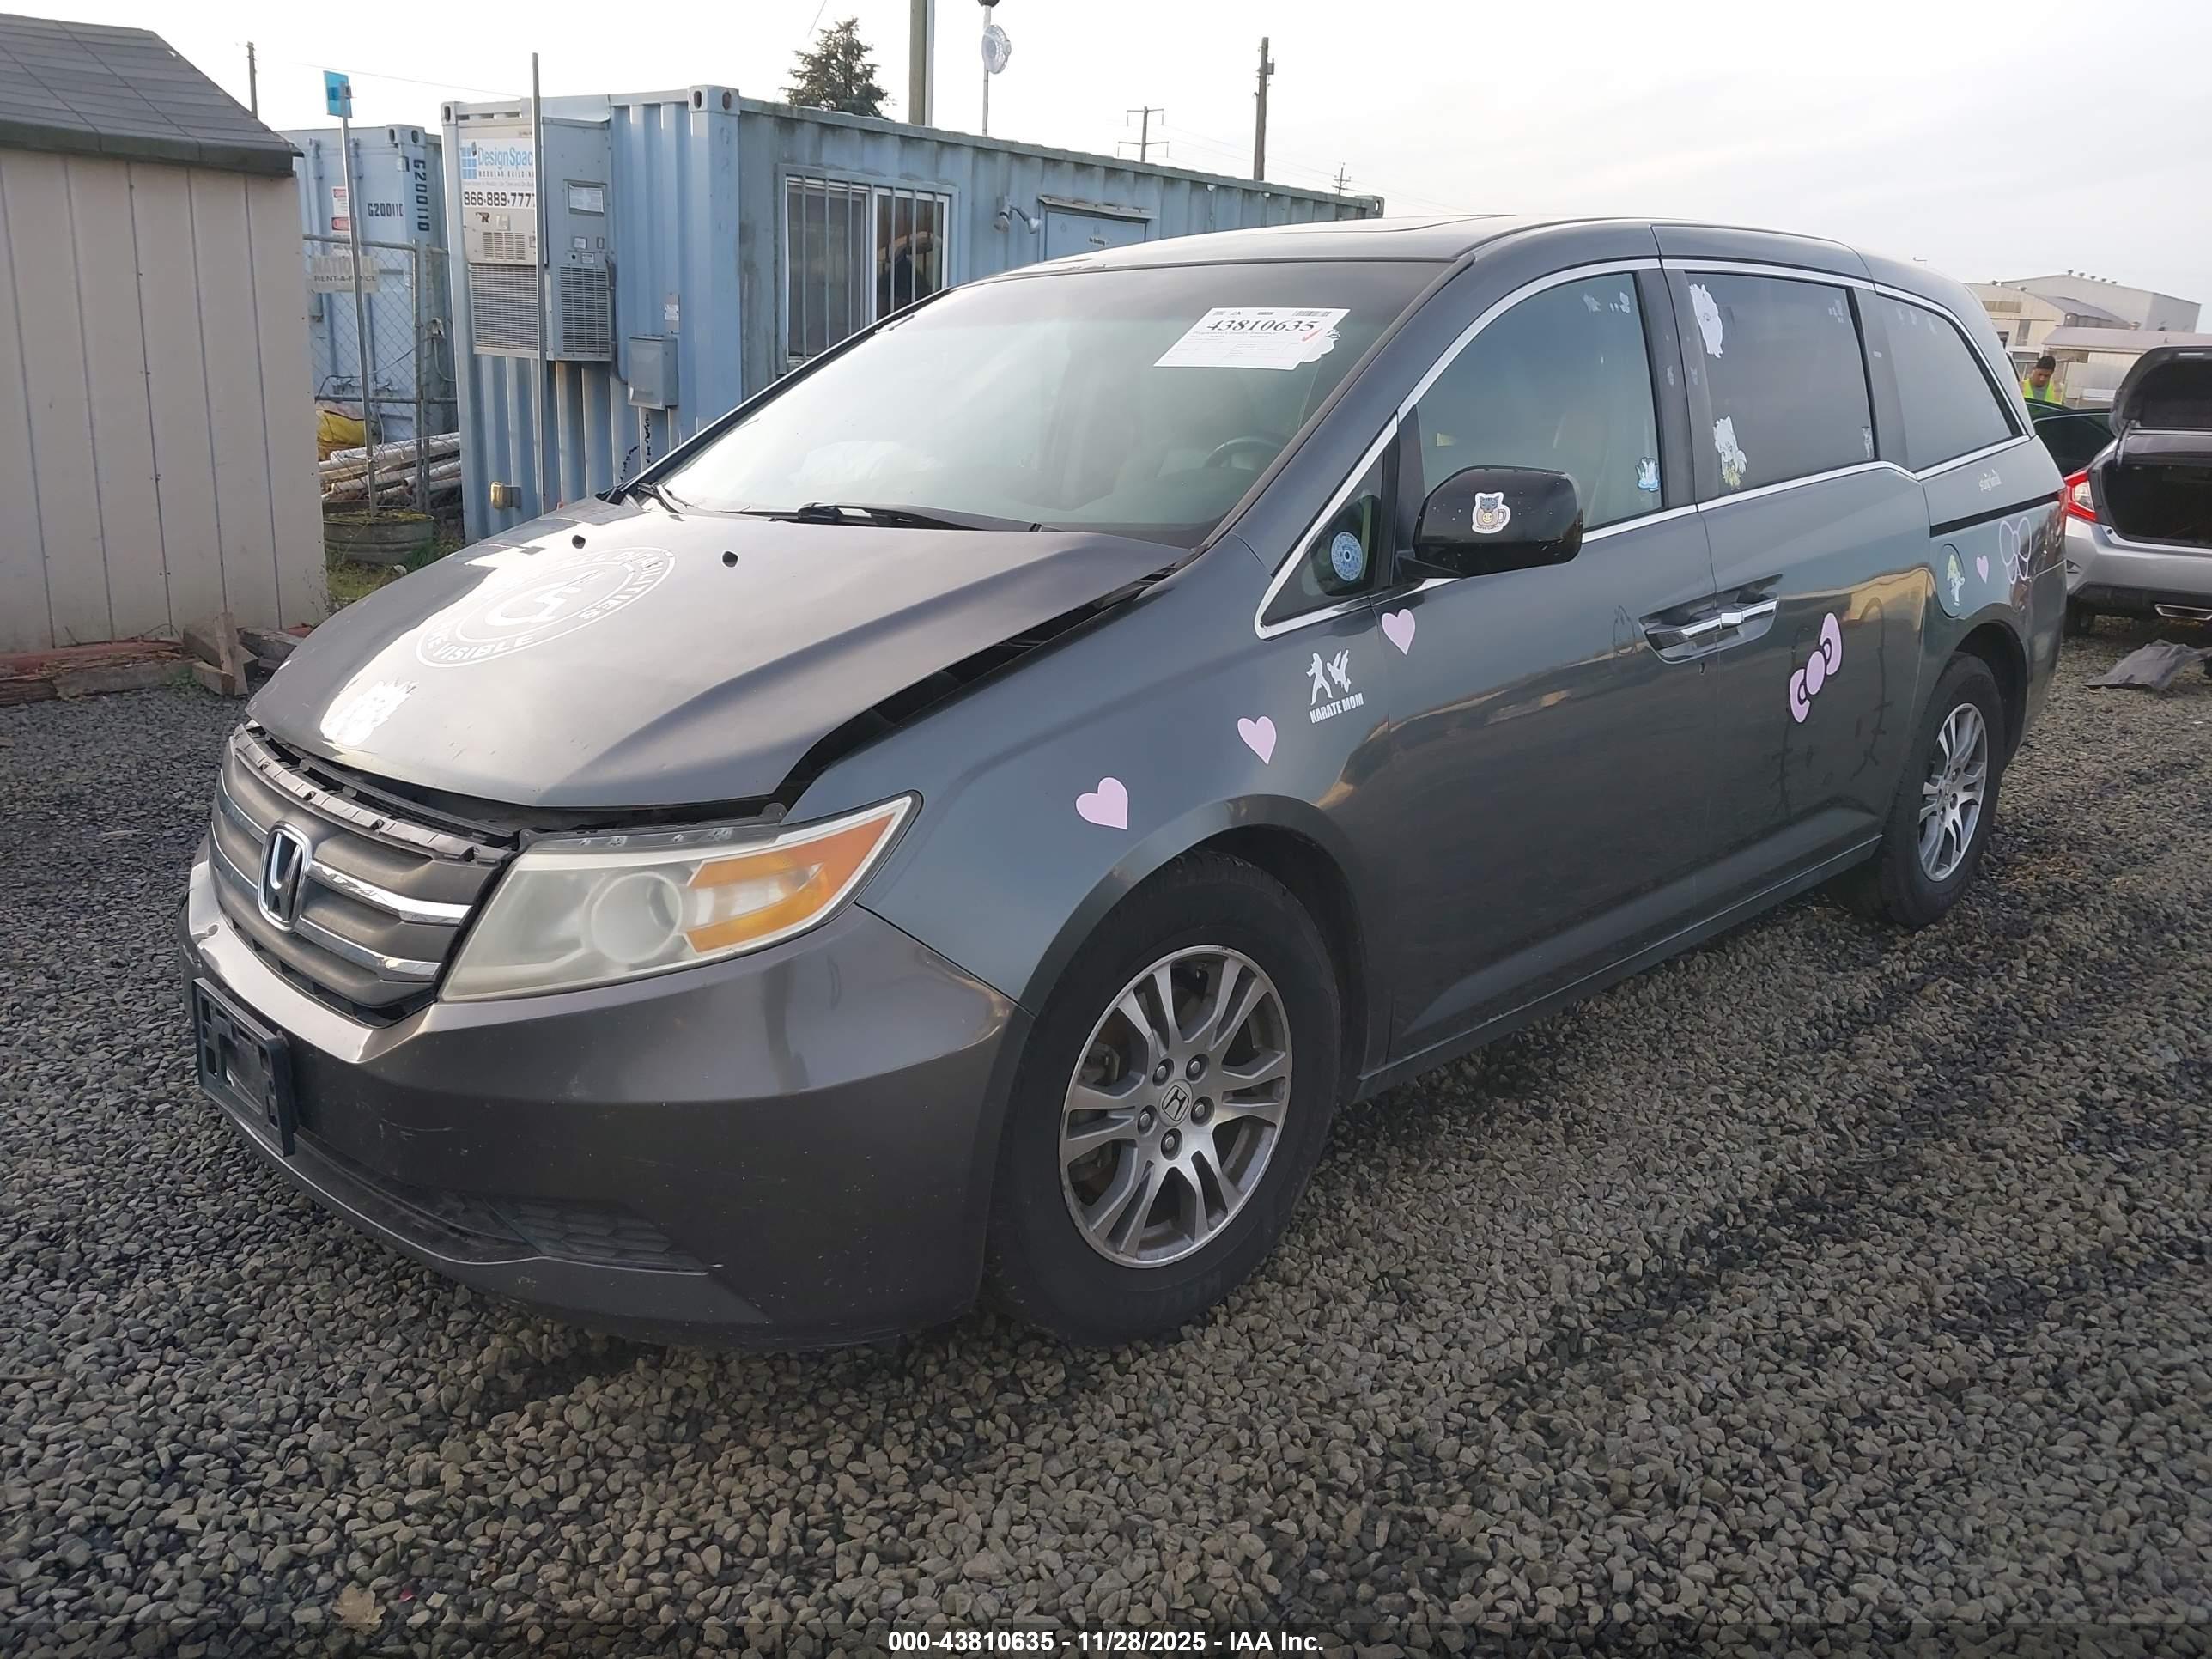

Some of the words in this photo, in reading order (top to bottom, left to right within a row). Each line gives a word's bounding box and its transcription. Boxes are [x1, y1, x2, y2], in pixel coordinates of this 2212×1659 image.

[478, 147, 533, 170] DesignSpac
[414, 159, 429, 232] G200110
[1206, 320, 1321, 331] 43810635
[433, 634, 536, 661] VISIBLE
[1310, 701, 1342, 724] KARATE
[1341, 693, 1364, 712] MOM
